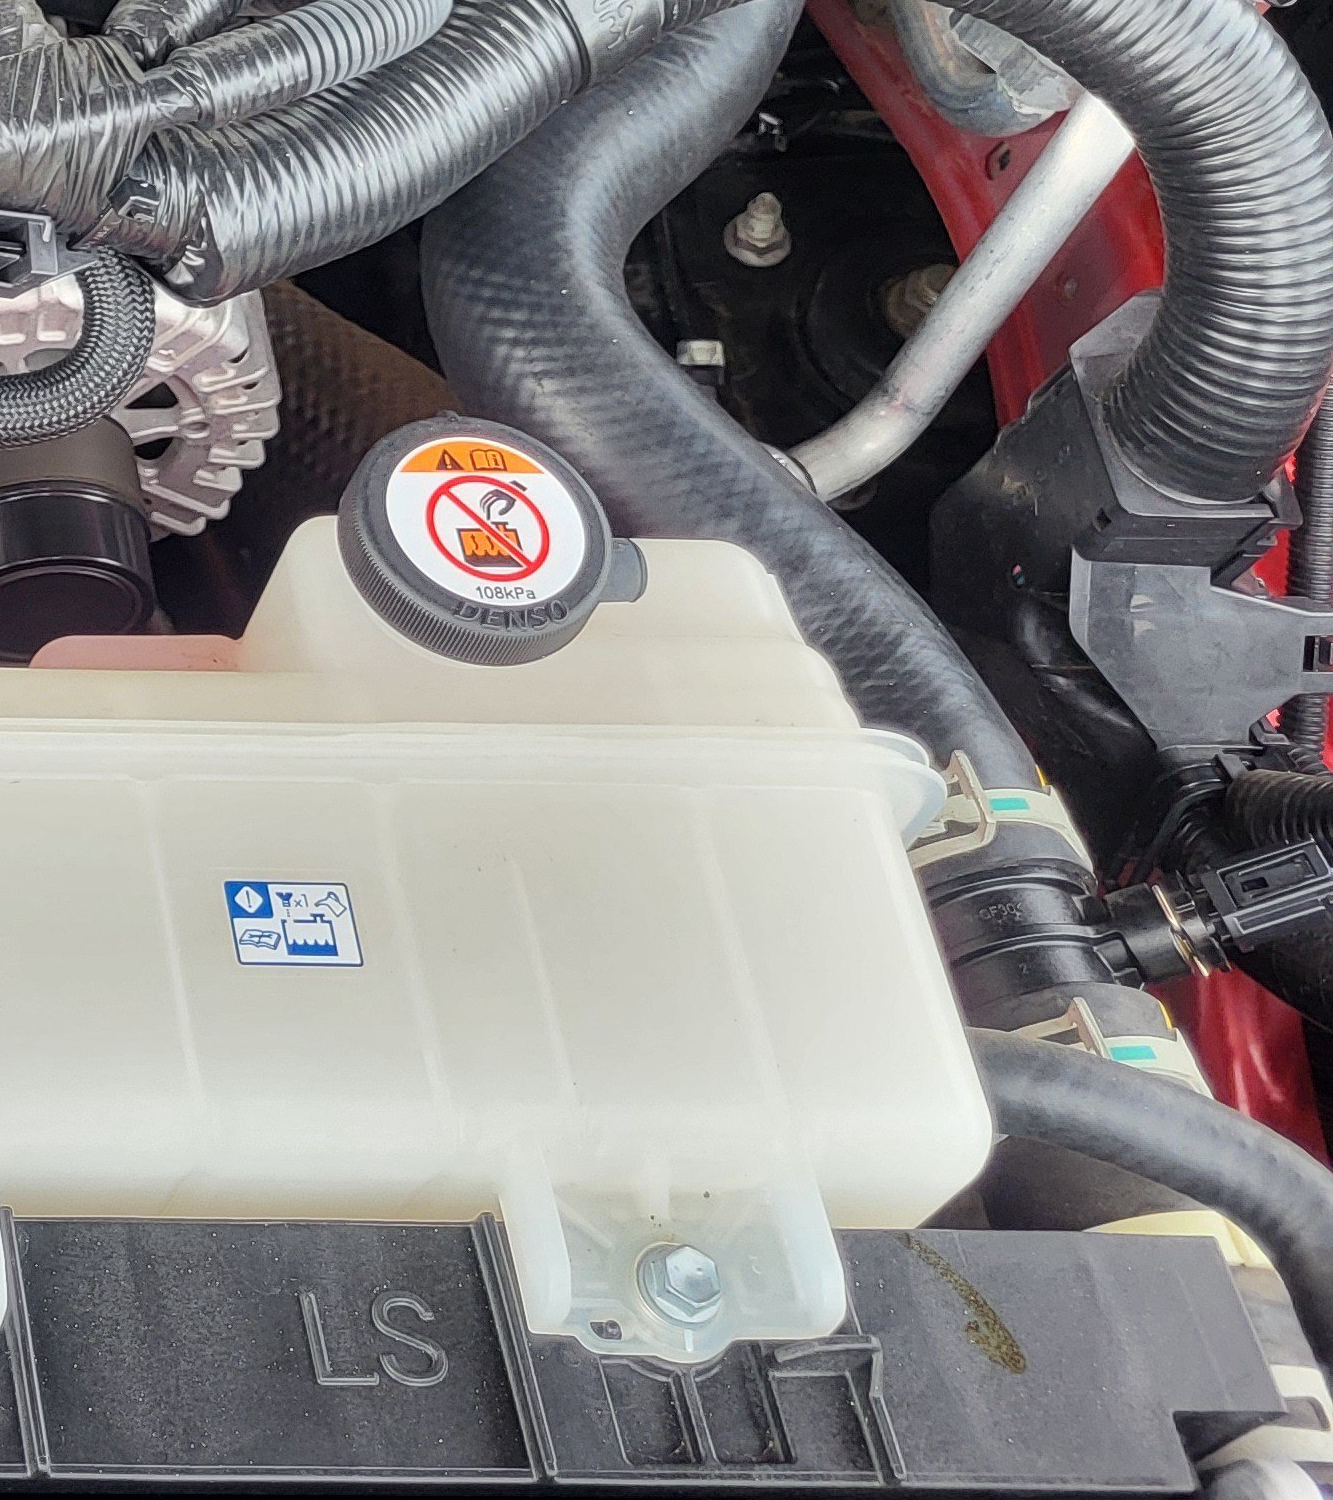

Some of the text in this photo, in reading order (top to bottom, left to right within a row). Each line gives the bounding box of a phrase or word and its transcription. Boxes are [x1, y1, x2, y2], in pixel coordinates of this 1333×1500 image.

[475, 585, 537, 601] 108kPa
[453, 599, 570, 632] DENSO
[299, 1287, 449, 1387] LS
